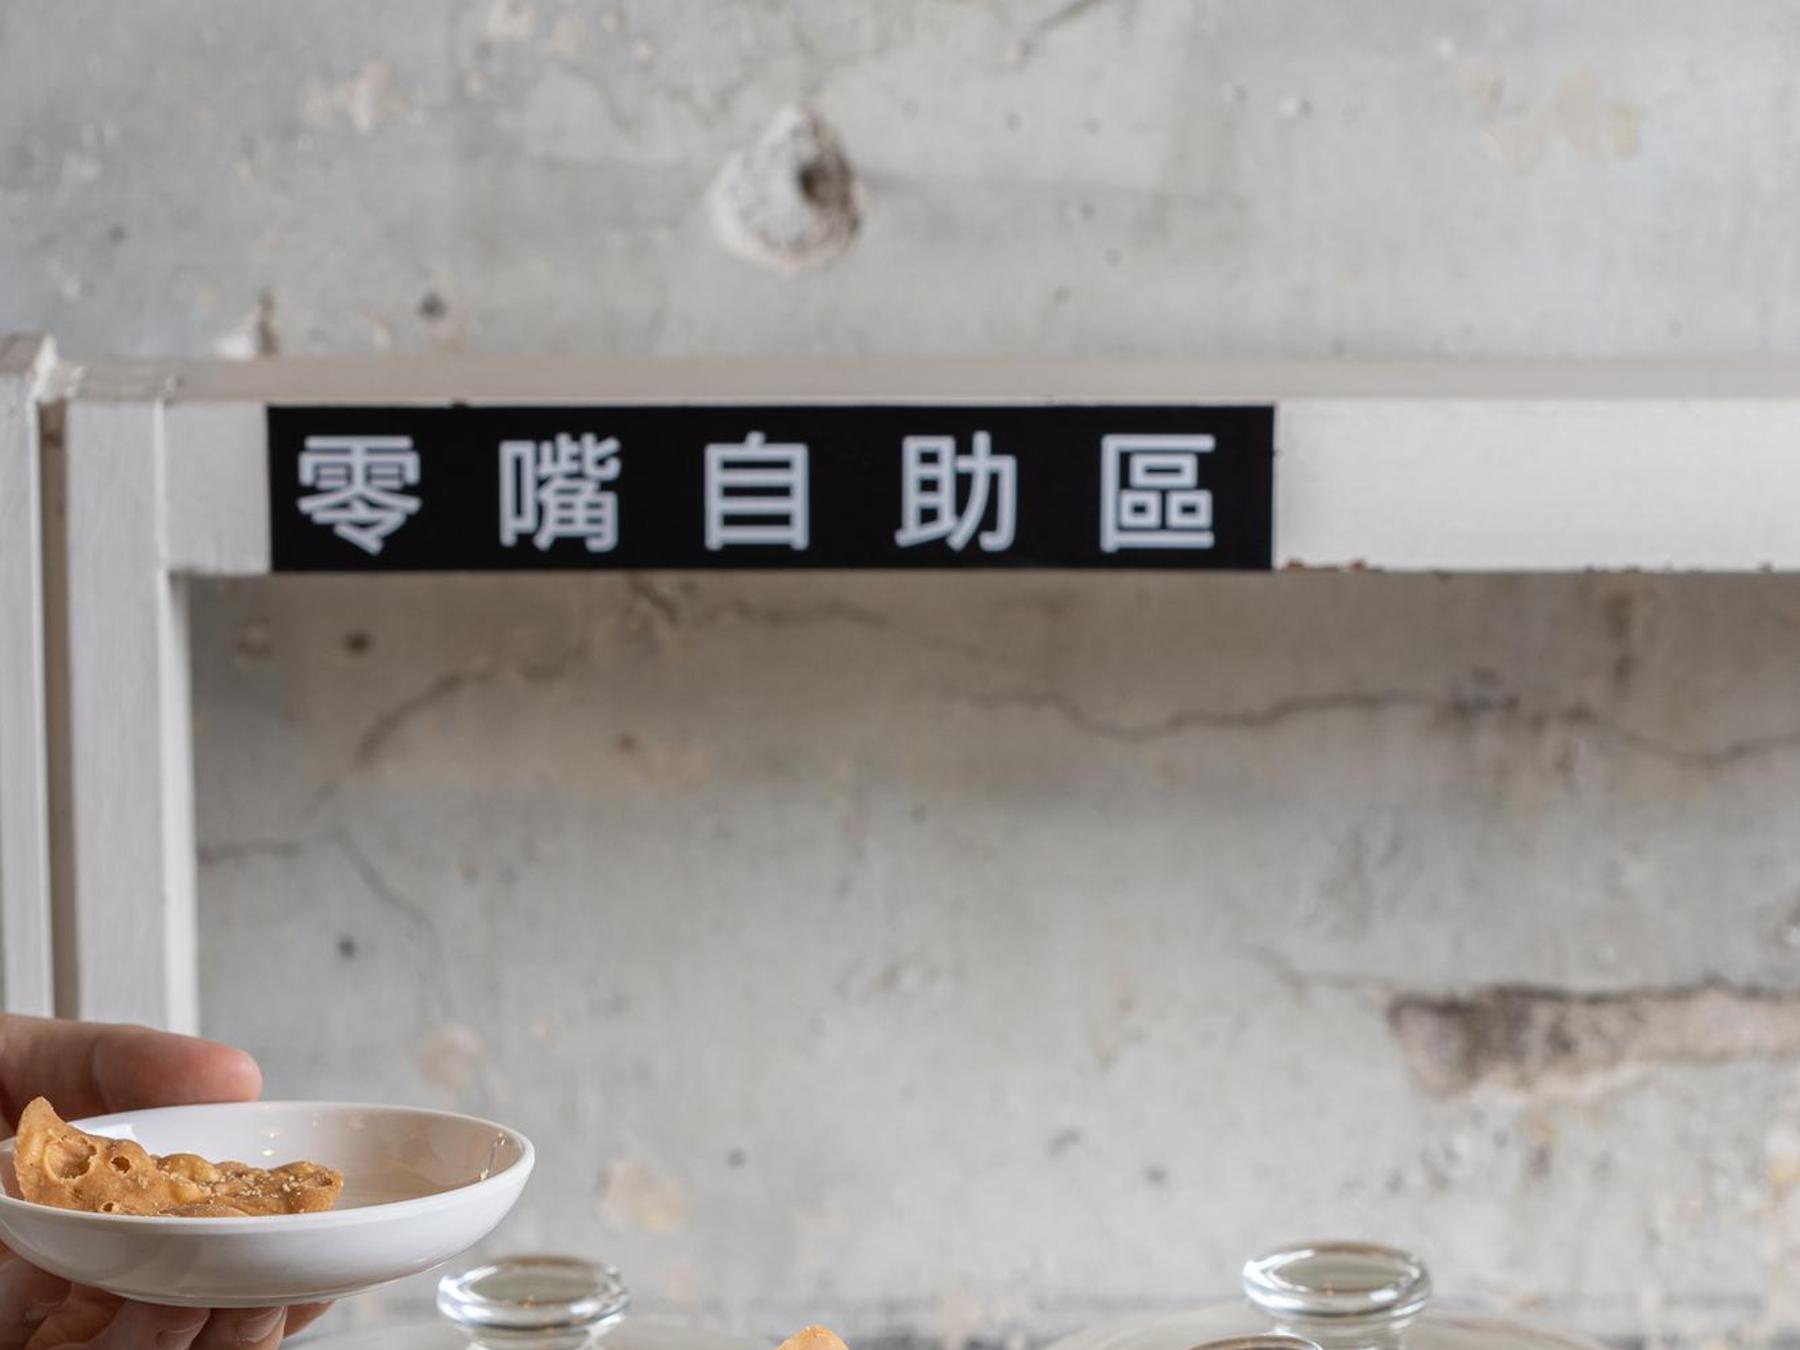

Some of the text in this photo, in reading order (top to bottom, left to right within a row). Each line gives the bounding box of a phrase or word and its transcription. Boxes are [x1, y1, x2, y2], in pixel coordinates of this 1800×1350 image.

[297, 432, 1216, 553] 零嘴自助區
